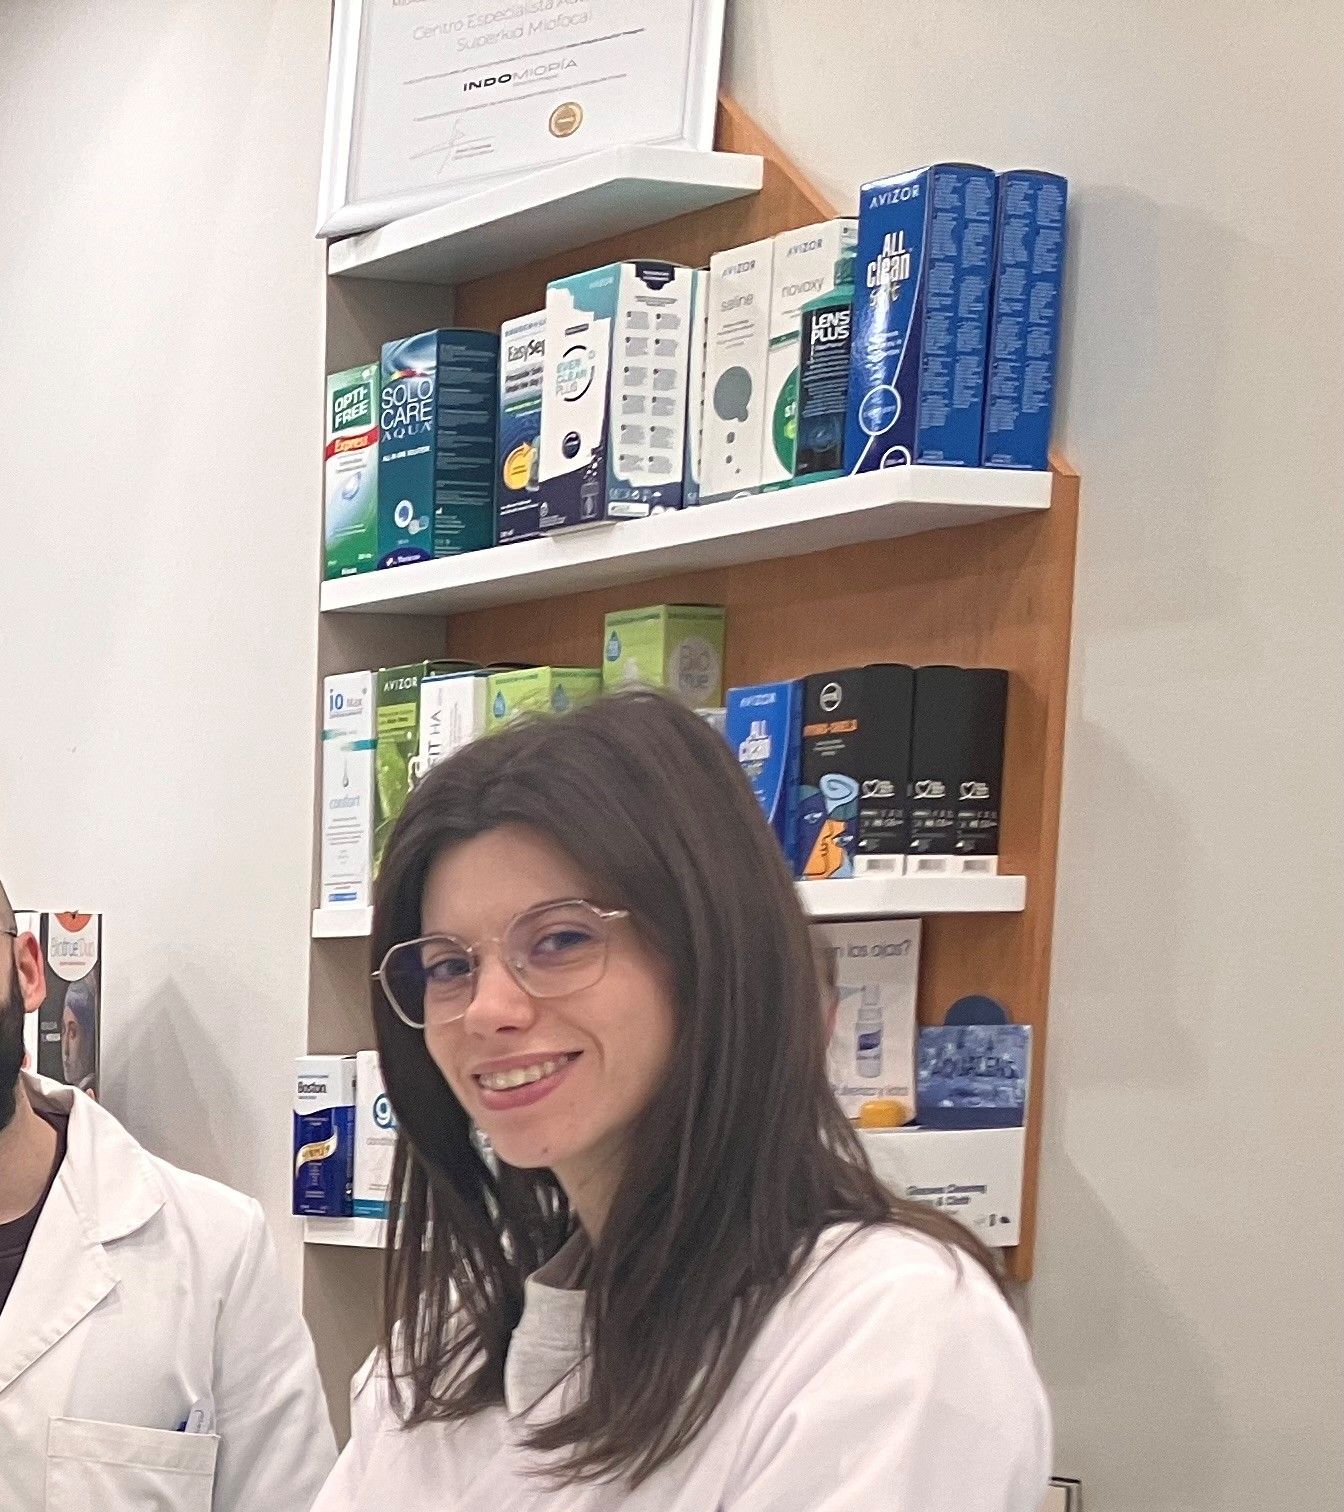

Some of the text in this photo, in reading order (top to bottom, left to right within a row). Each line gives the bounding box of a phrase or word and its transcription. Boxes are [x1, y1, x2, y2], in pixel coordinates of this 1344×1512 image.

[869, 184, 920, 209] AVIZOR
[787, 238, 823, 258] AVIZOR
[883, 229, 906, 257] ALL
[867, 253, 910, 288] clean
[812, 310, 851, 329] LENS
[811, 325, 851, 345] PLUS
[334, 386, 368, 413] OPTI-
[381, 378, 434, 409] SOLO
[334, 399, 370, 429] FREE
[380, 398, 434, 430] CARE
[381, 420, 433, 443] AQUA
[383, 676, 418, 692] AVIZOR
[297, 1081, 328, 1094] Boston
